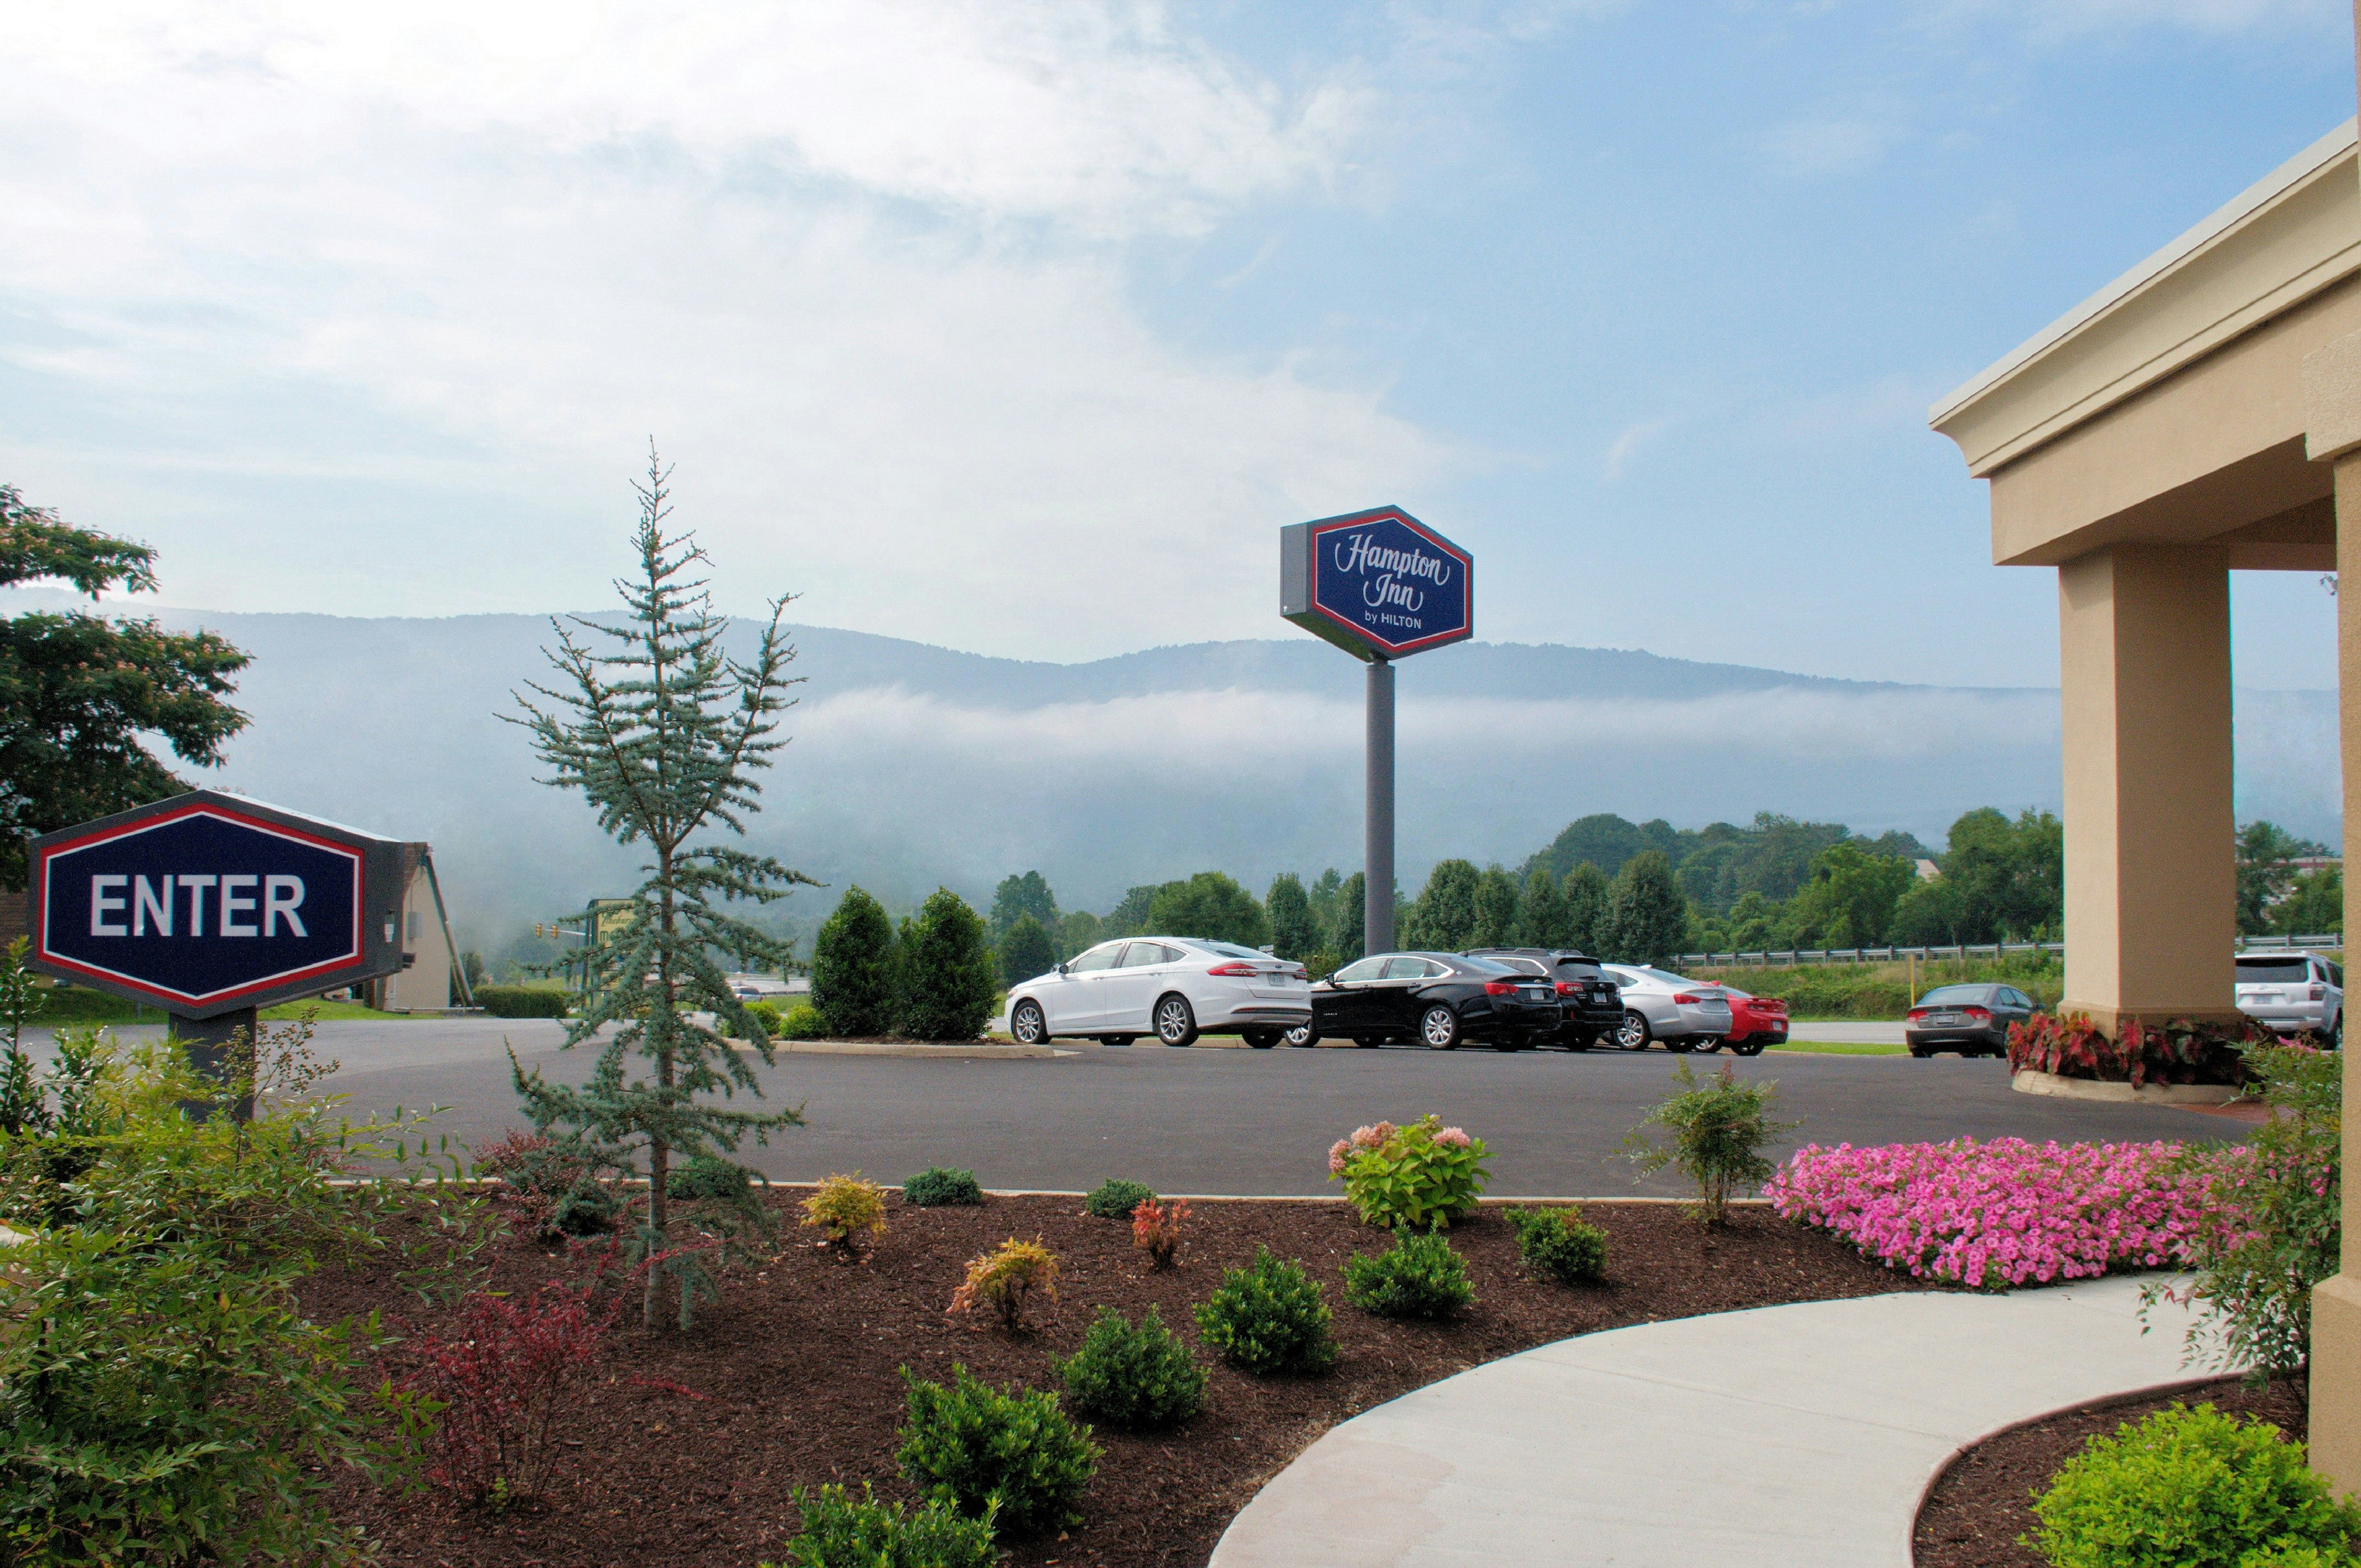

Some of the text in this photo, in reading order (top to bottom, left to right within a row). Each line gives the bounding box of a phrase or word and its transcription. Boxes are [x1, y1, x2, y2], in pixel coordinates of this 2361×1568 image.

[1335, 534, 1450, 586] Hampton
[1363, 574, 1423, 612] Inn
[1365, 610, 1422, 629] by HILTON
[91, 874, 308, 937] ENTER
